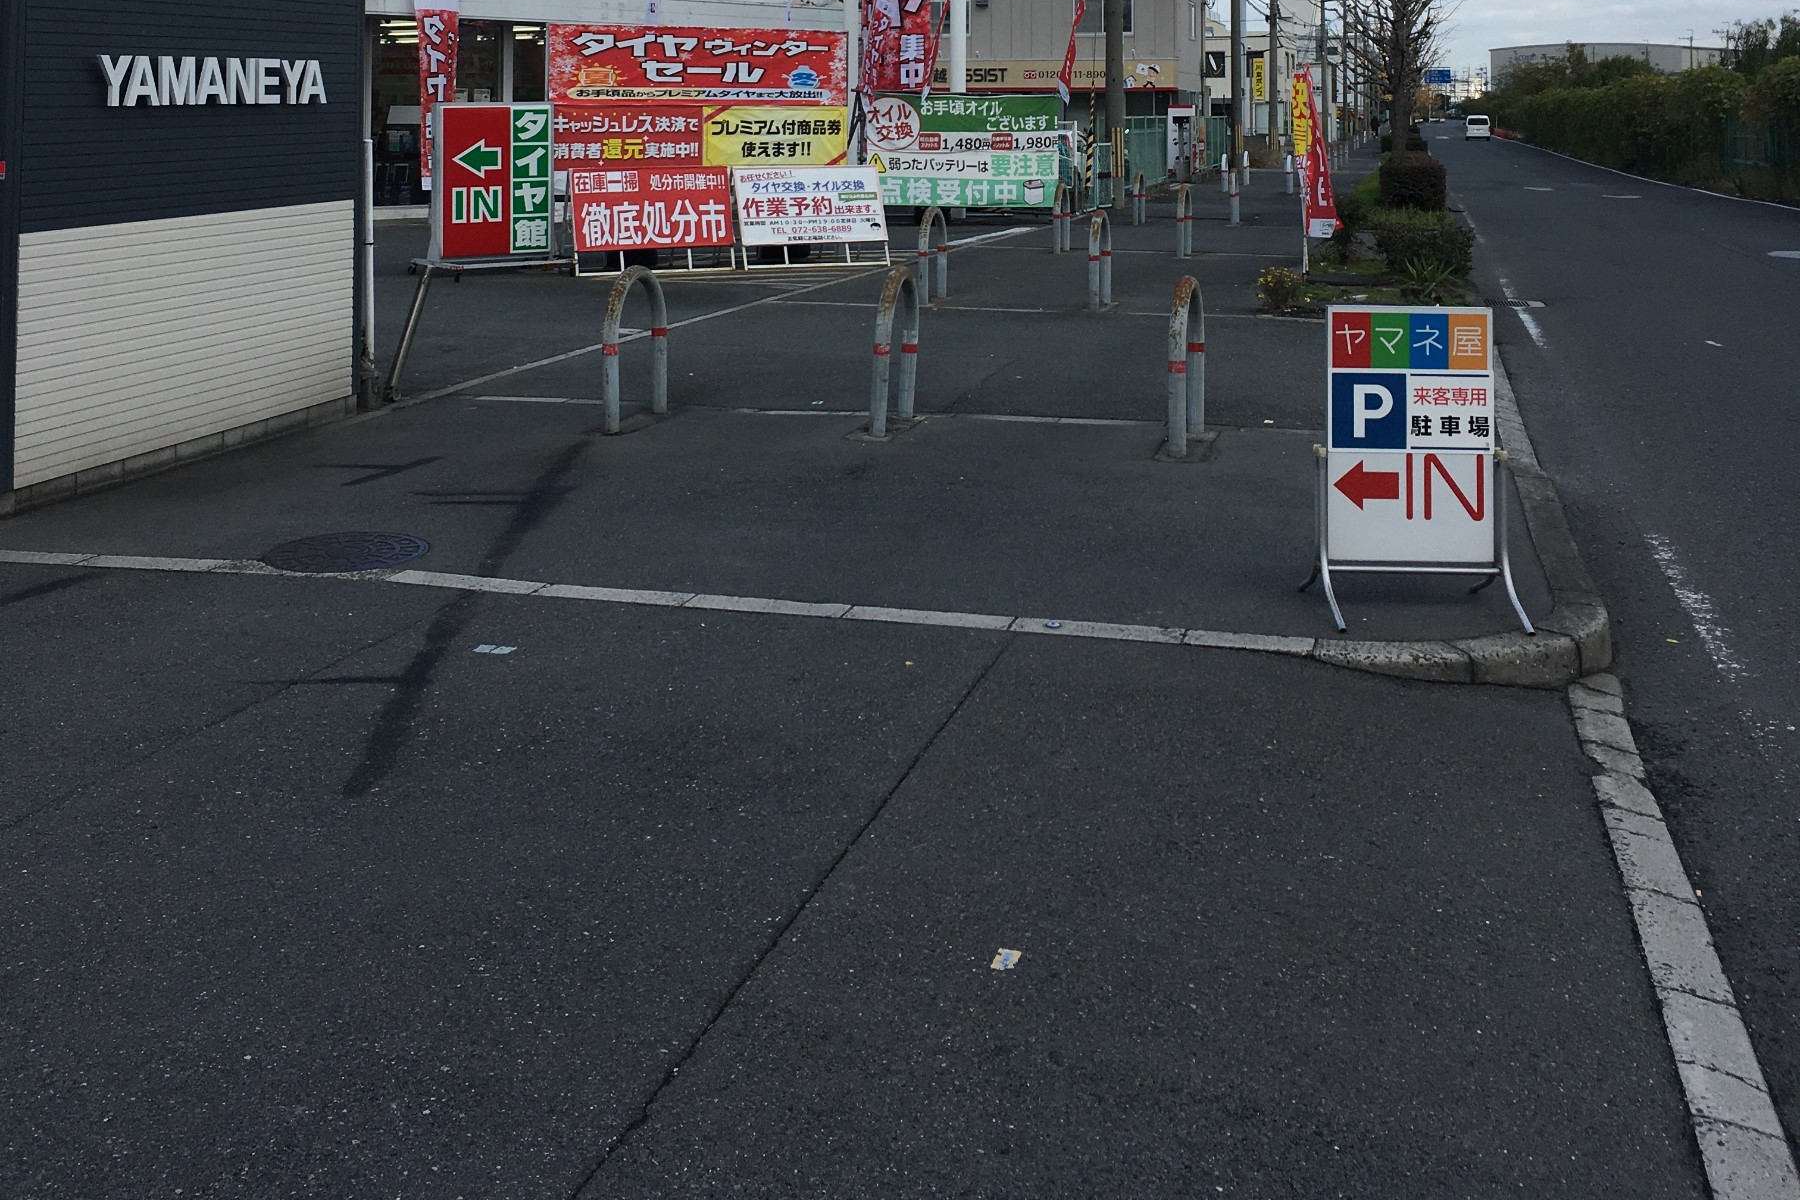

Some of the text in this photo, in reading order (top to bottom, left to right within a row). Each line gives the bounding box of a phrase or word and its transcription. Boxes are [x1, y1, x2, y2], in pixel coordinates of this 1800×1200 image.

[572, 32, 829, 58] タイヤ ウィンター
[97, 54, 328, 107] YAMANEYA
[641, 60, 764, 84] セール
[868, 103, 912, 124] オイル
[920, 100, 1003, 117] お手頃オイル
[554, 115, 698, 134] キャッシュレス決済で
[711, 119, 842, 136] プレミアム付商品券
[876, 122, 915, 143] 交換
[741, 141, 812, 158] 使えます!!
[942, 137, 991, 151] 1,480円
[514, 111, 549, 248] タイヤ館
[574, 172, 638, 192] 在庫一掃
[880, 178, 1018, 205] 点検受付中
[451, 186, 503, 225] IN
[581, 199, 727, 247] 徹底処分市
[771, 225, 853, 234] TEL 072-638-6889
[1335, 323, 1483, 357] ヤマネ屋
[1413, 387, 1487, 406] 来客専用
[1353, 384, 1394, 438] P
[1411, 415, 1490, 438] 駐車場
[1405, 453, 1485, 522] IN
